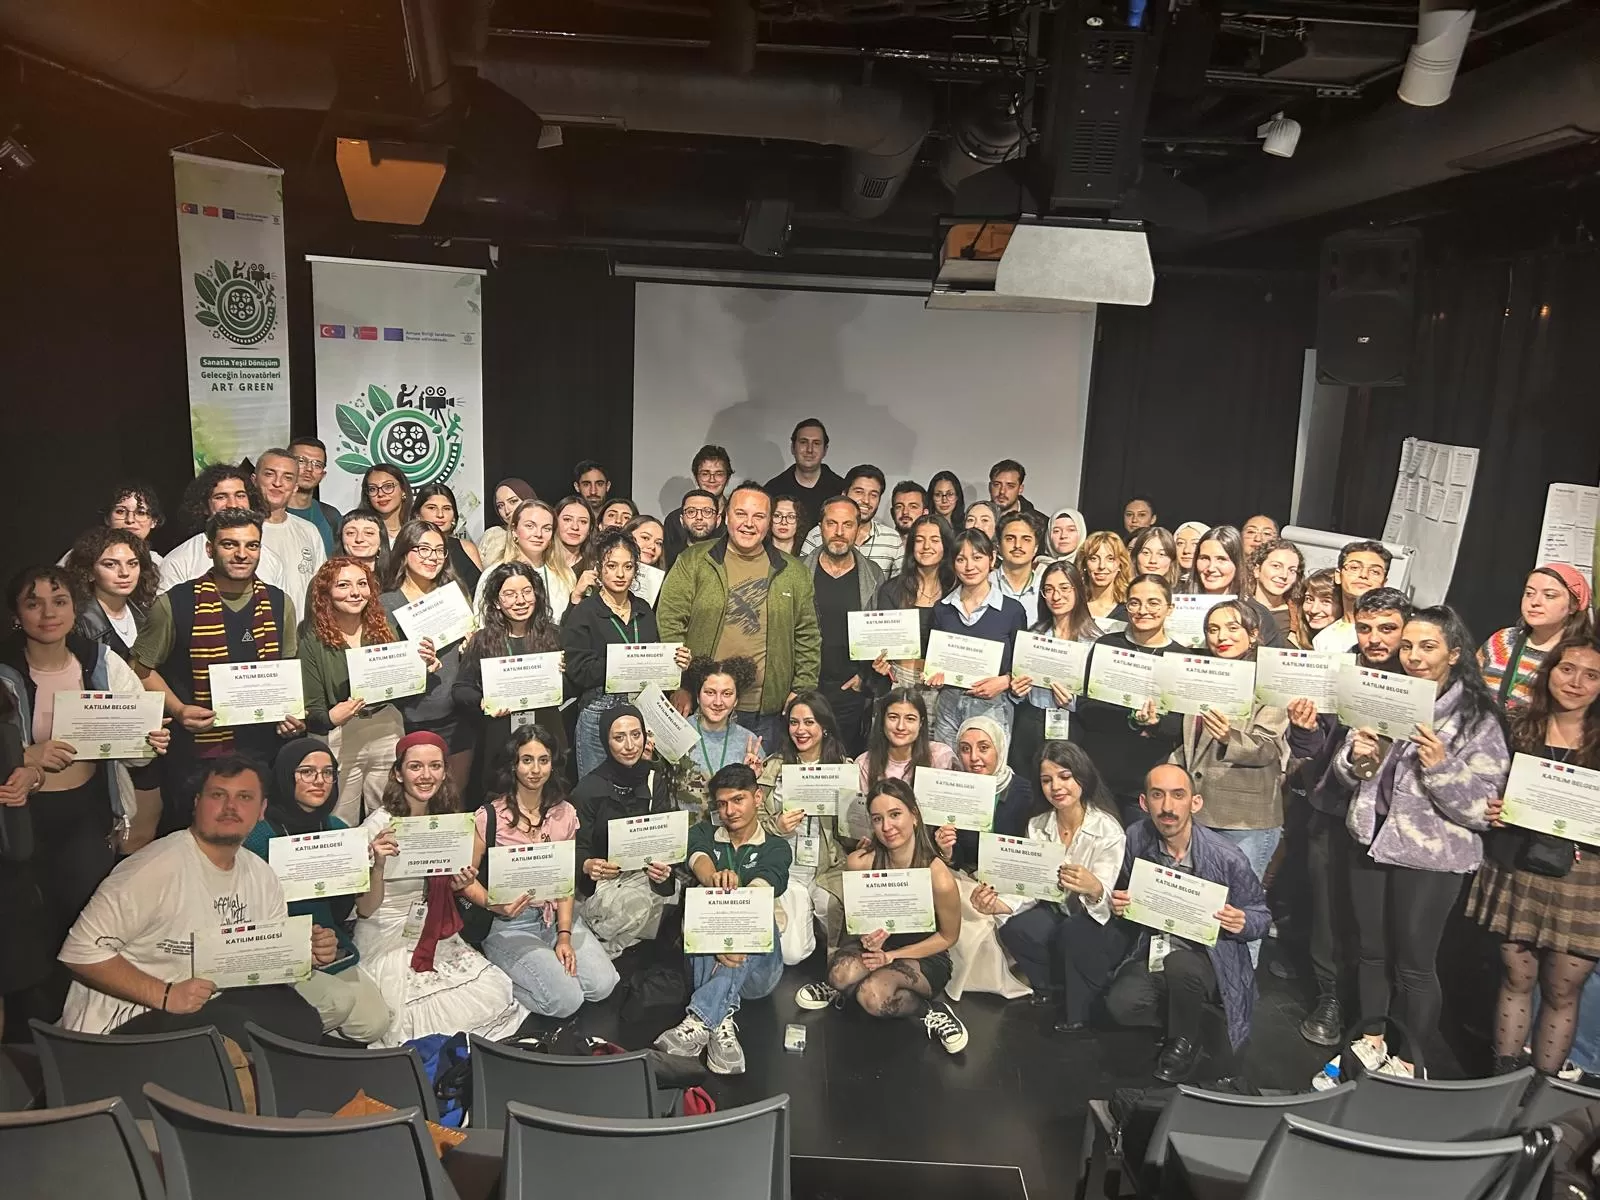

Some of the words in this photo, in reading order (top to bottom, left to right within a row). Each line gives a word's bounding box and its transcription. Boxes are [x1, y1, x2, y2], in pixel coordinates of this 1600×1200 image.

[231, 359, 247, 367] Yeşil
[201, 371, 238, 380] Geleceğin
[211, 383, 234, 391] ART
[239, 383, 274, 391] GREEN
[1362, 681, 1385, 690] KATILIM
[1543, 773, 1571, 784] KATILIM
[1155, 878, 1178, 888] KATILIM
[226, 936, 254, 944] KATILIM
[255, 932, 283, 941] BELGESİ
